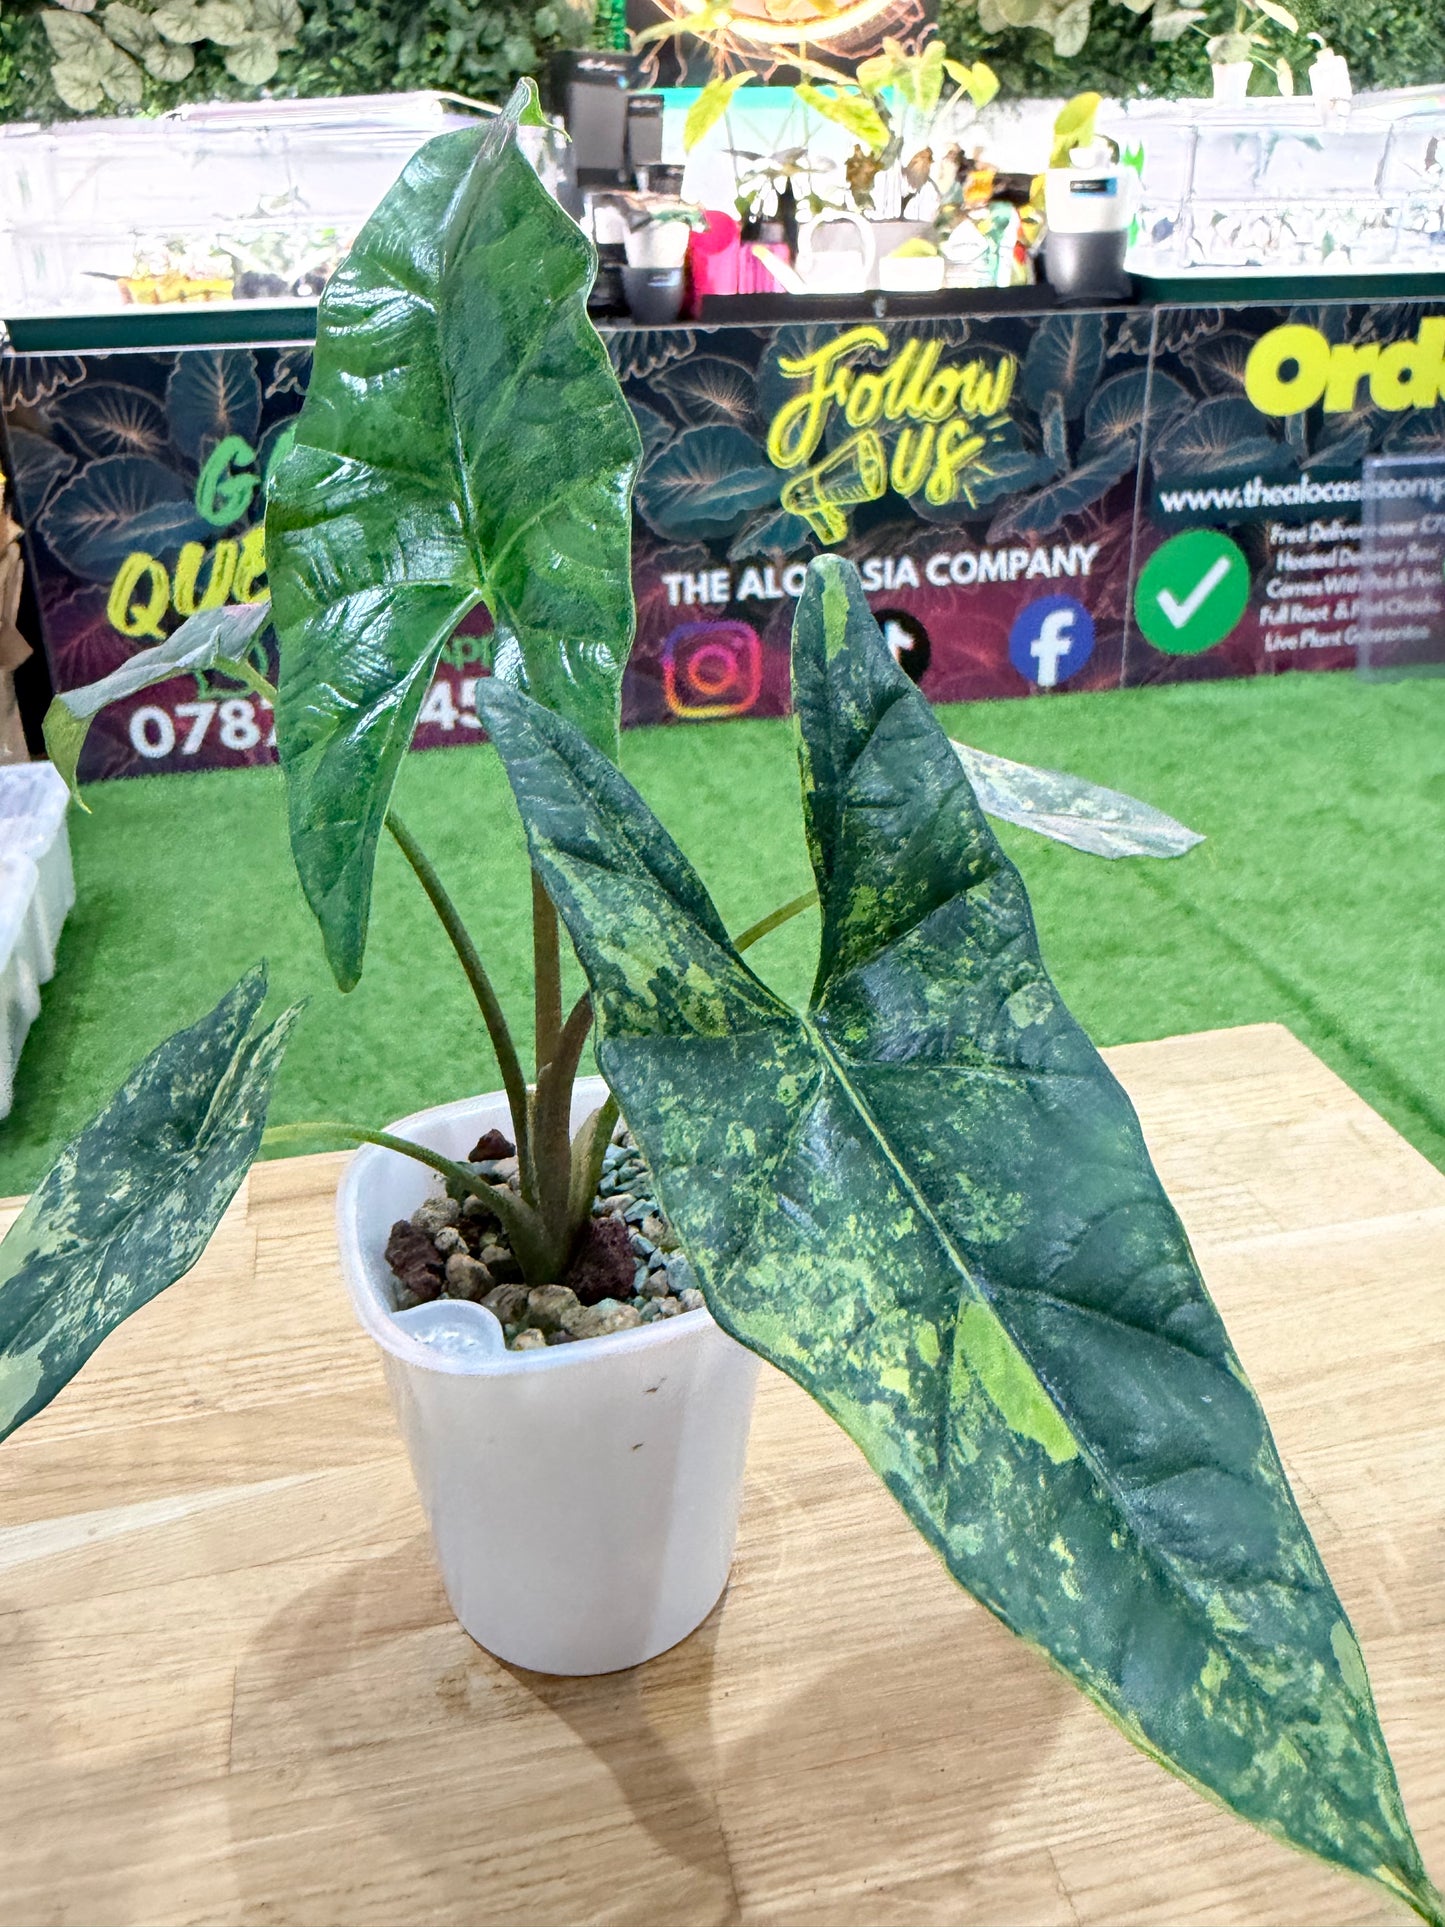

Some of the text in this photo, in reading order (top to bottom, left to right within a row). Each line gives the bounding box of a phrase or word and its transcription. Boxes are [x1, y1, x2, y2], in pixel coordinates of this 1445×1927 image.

[767, 325, 1018, 468] Follow
[1245, 315, 1445, 417] Ord
[662, 543, 1100, 607] THE ALOSIA COMPANY
[129, 698, 277, 759] 078
